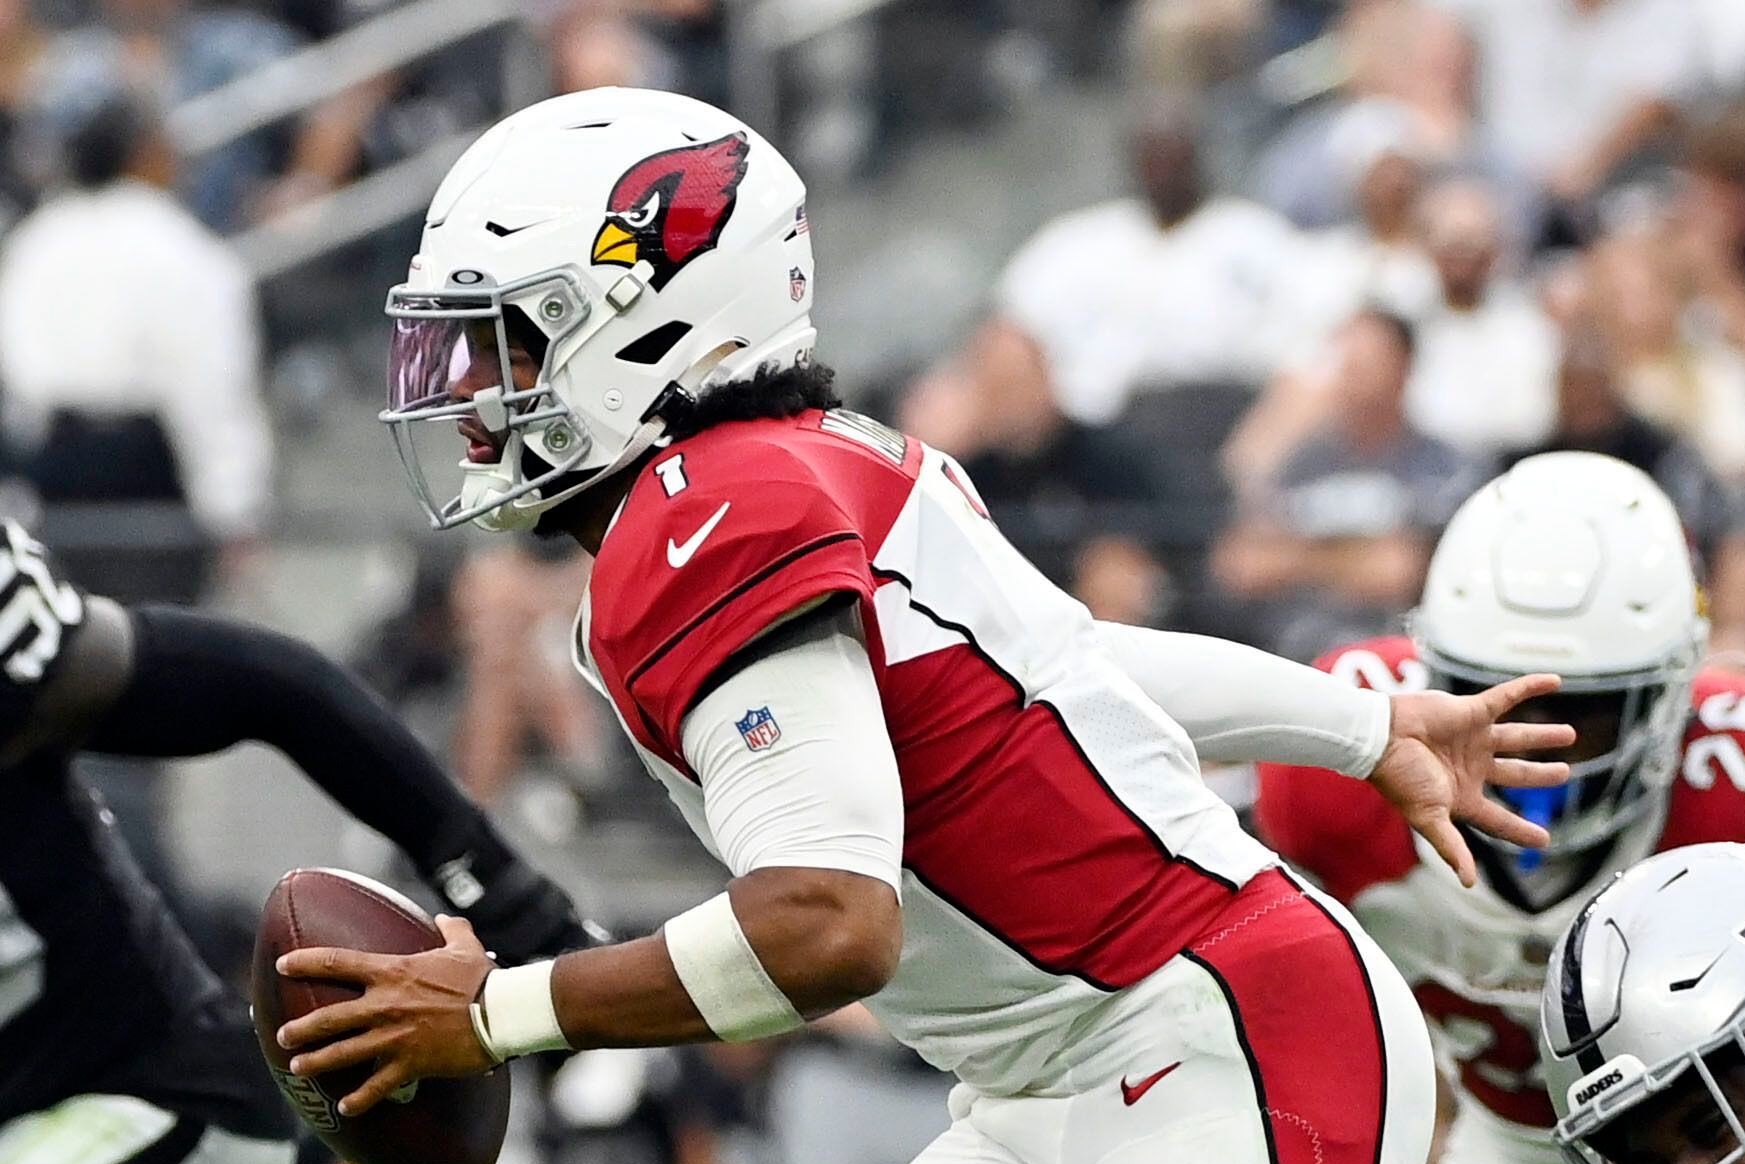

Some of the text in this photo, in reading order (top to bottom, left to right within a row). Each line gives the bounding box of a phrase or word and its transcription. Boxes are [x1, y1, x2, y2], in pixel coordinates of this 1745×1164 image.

[653, 453, 688, 498] 1
[746, 722, 777, 748] NFL
[1575, 1068, 1624, 1106] RAIDERS
